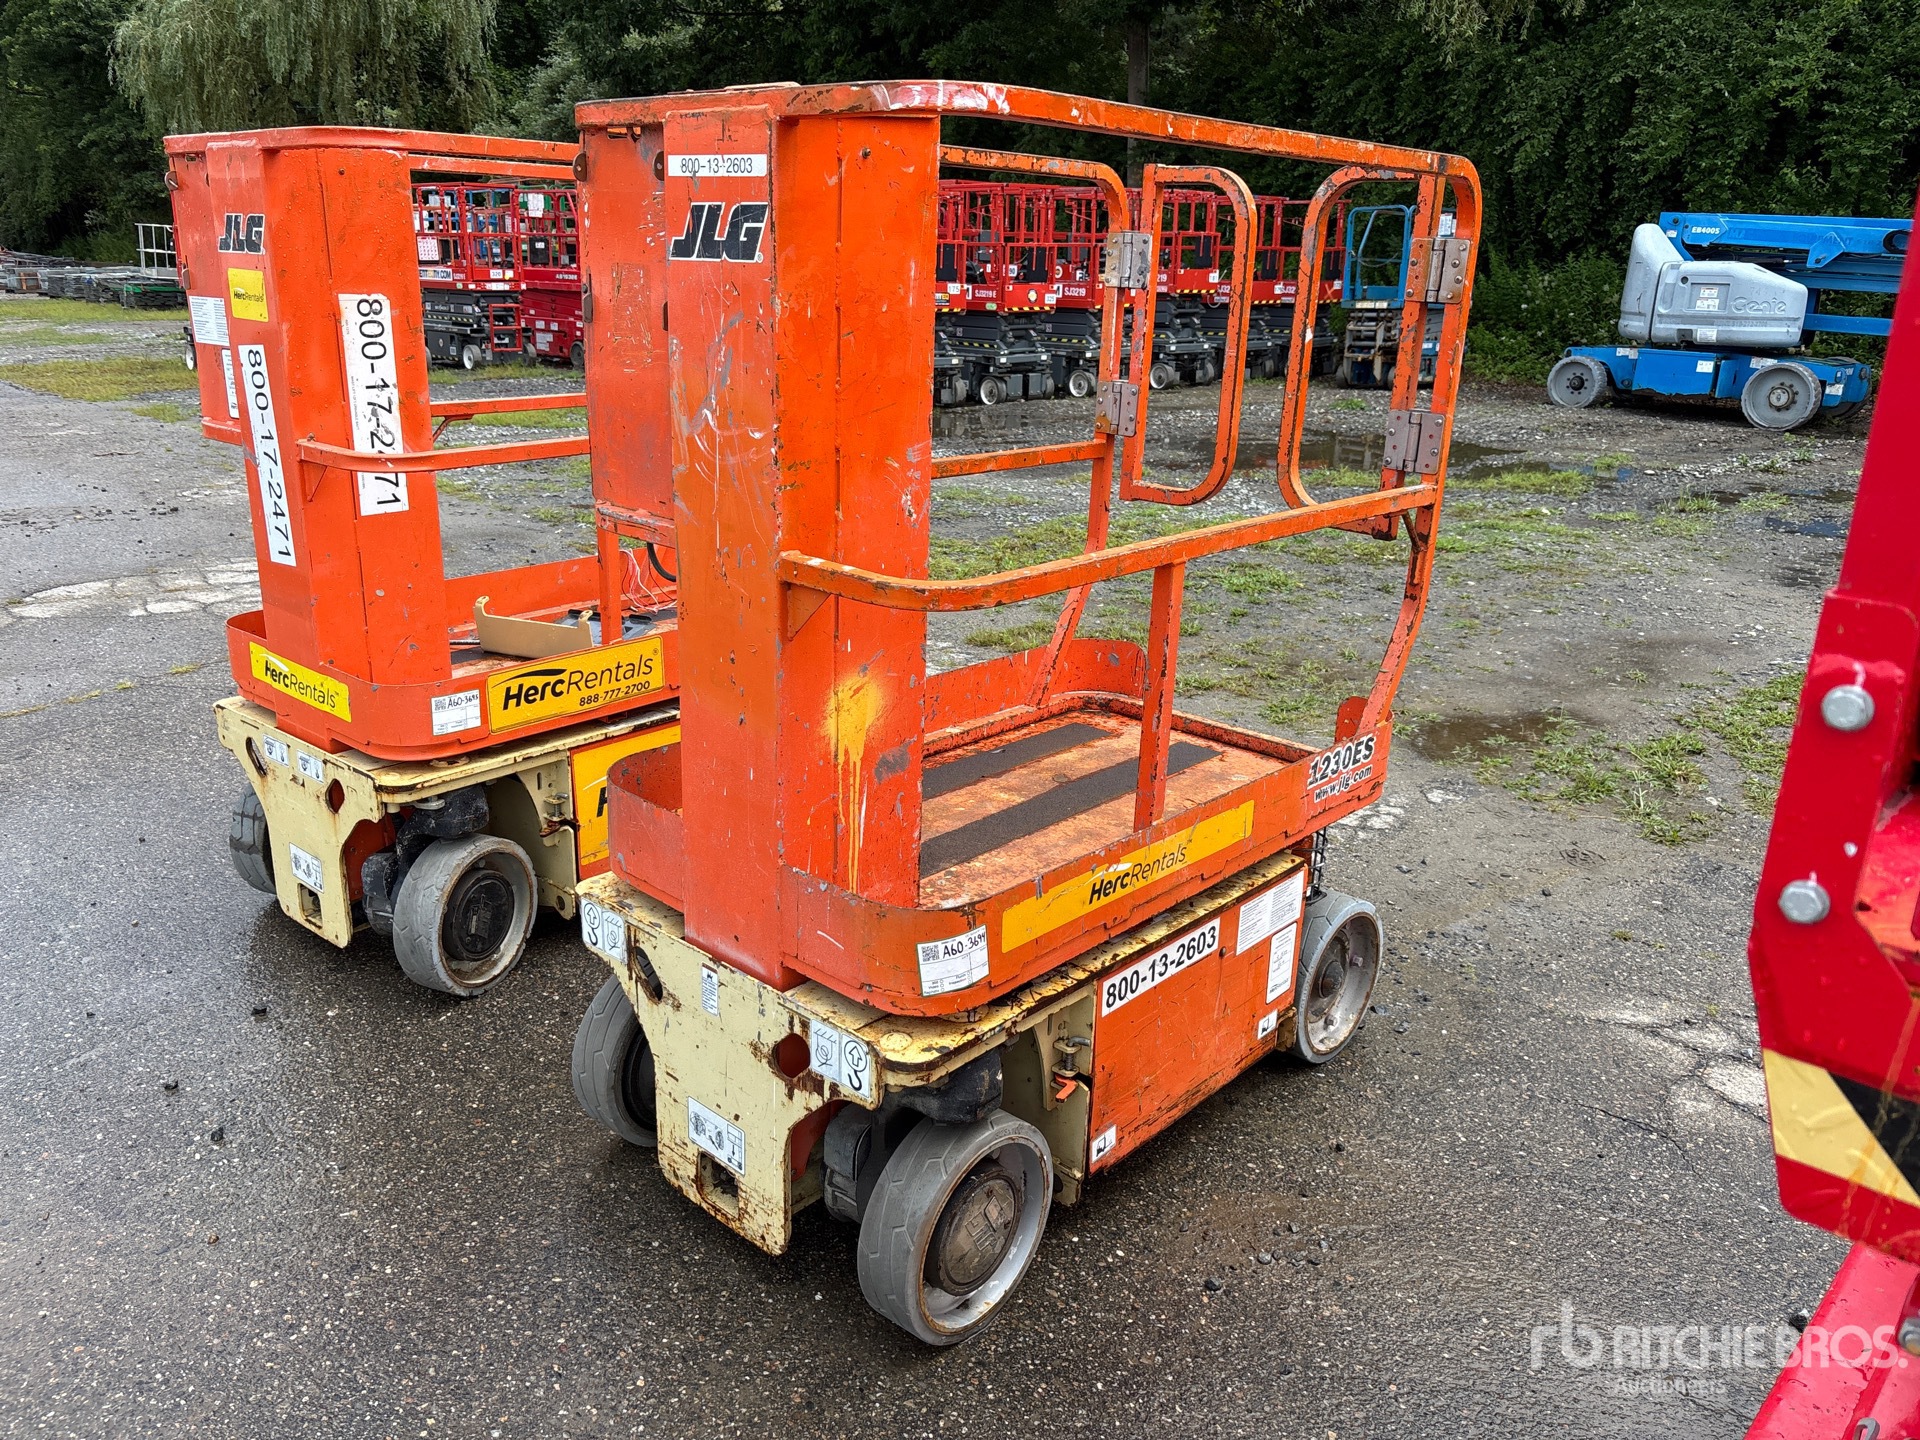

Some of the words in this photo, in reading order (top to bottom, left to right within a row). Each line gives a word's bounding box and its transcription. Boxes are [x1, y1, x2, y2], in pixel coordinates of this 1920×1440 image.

[680, 157, 753, 174] 800-13-2603
[218, 213, 266, 255] JLG
[669, 202, 769, 262] JLG
[1731, 296, 1787, 315] Genie
[357, 298, 402, 505] 800-17-271
[247, 349, 292, 558] 800-17-2471
[264, 660, 336, 709] HercRentals
[503, 654, 654, 711] HercRentals
[579, 680, 650, 707] 888-777-2700
[1307, 735, 1376, 787] 1230ES
[1314, 765, 1373, 802] www.jlg.com
[1088, 844, 1188, 905] HercRentals
[1106, 926, 1216, 1008] 800-13-2603
